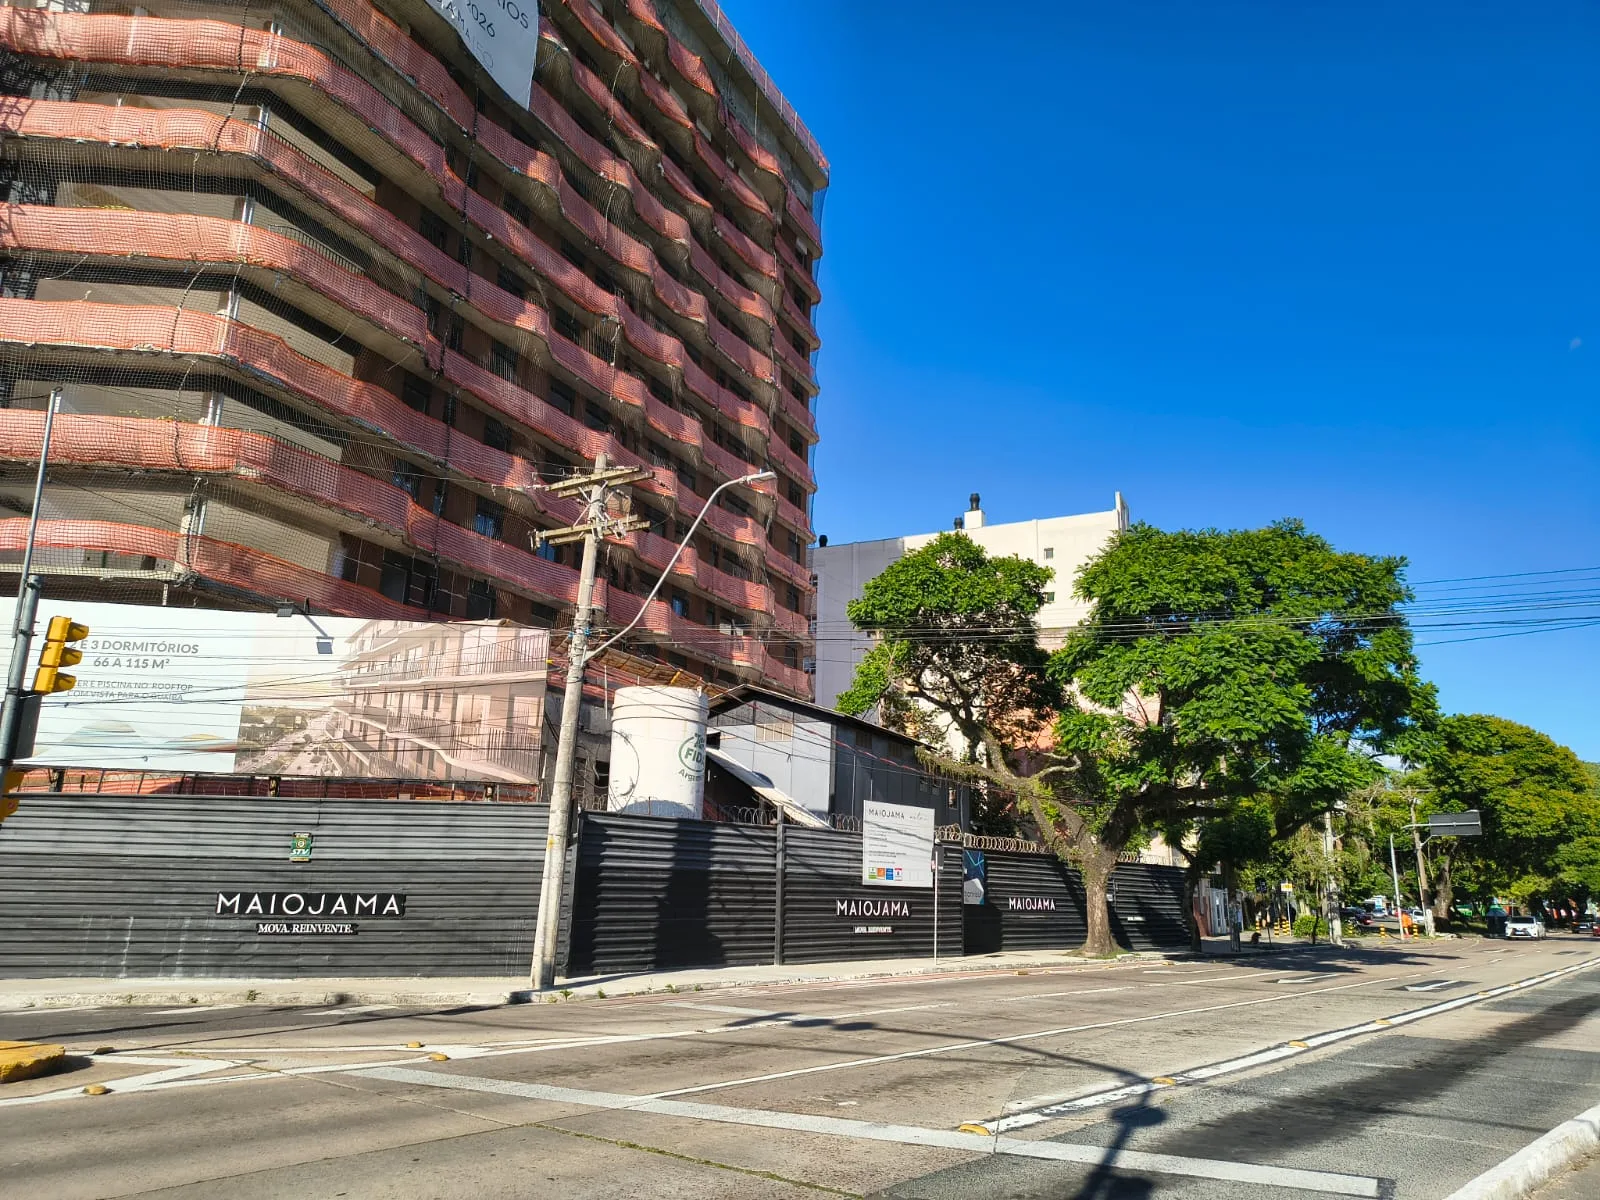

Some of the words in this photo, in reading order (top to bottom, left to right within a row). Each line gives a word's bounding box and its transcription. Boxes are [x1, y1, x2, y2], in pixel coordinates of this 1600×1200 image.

[466, 0, 496, 38] 026
[496, 0, 529, 29] IOS
[80, 640, 88, 649] E
[91, 640, 99, 649] 3
[101, 640, 200, 654] DORMITÓRIOS
[93, 656, 110, 667] 66
[112, 657, 121, 667] A
[126, 658, 149, 669] 115
[97, 680, 132, 689] PISCINA
[152, 682, 194, 691] ROOFTOP
[868, 808, 905, 820] MAIOJAMA
[216, 893, 400, 915] MAIOJAMA
[836, 899, 910, 917] MAIOJAMA
[1008, 897, 1056, 911] MAIOJAMA
[258, 923, 290, 934] MOVA.
[292, 923, 354, 935] REINVENTE.
